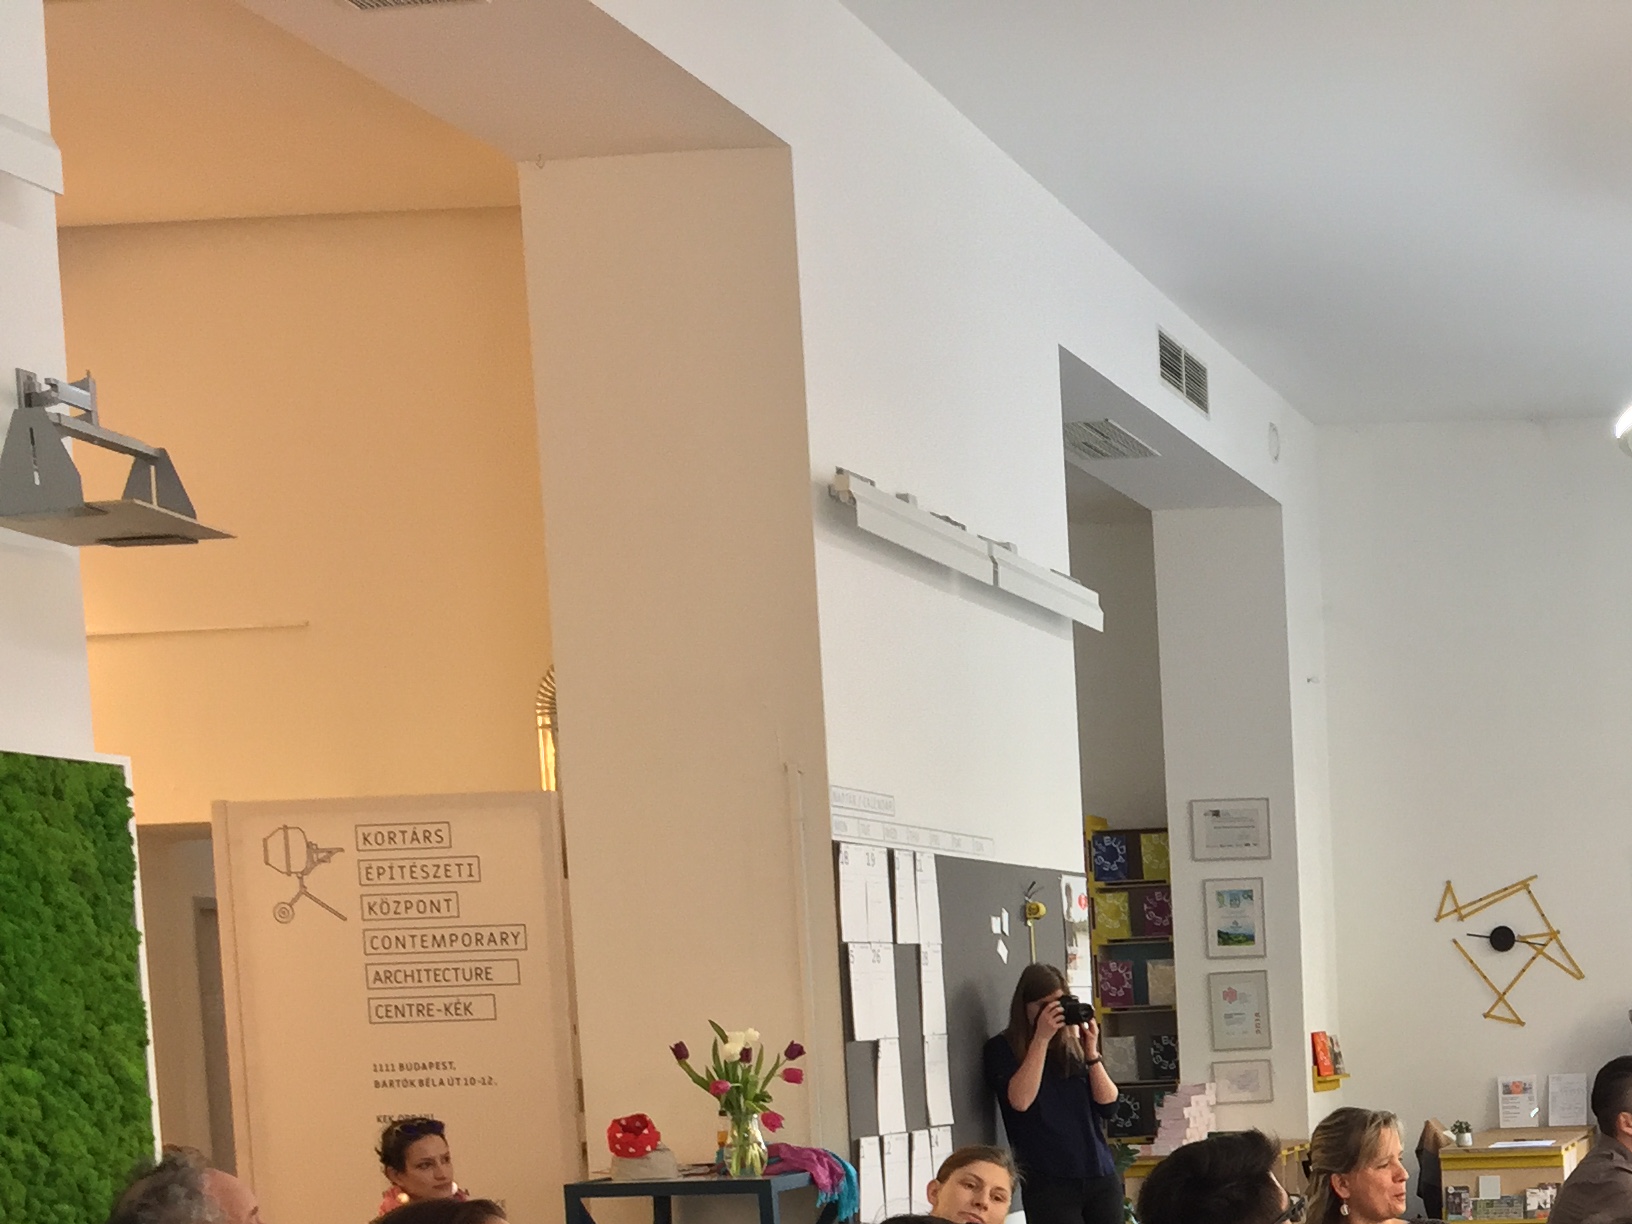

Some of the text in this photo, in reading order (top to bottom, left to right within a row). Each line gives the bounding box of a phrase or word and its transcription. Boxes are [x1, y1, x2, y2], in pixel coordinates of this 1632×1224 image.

[361, 826, 445, 847] KORTÁRS
[364, 861, 476, 882] ÉPÍTÉSZETI
[367, 895, 453, 917] KÖZPONT
[369, 931, 522, 951] CONTEMPORARY
[372, 966, 494, 985] ARCHITECTURE
[374, 998, 475, 1019] CENTRE-KÉK
[373, 1063, 396, 1073] 1111
